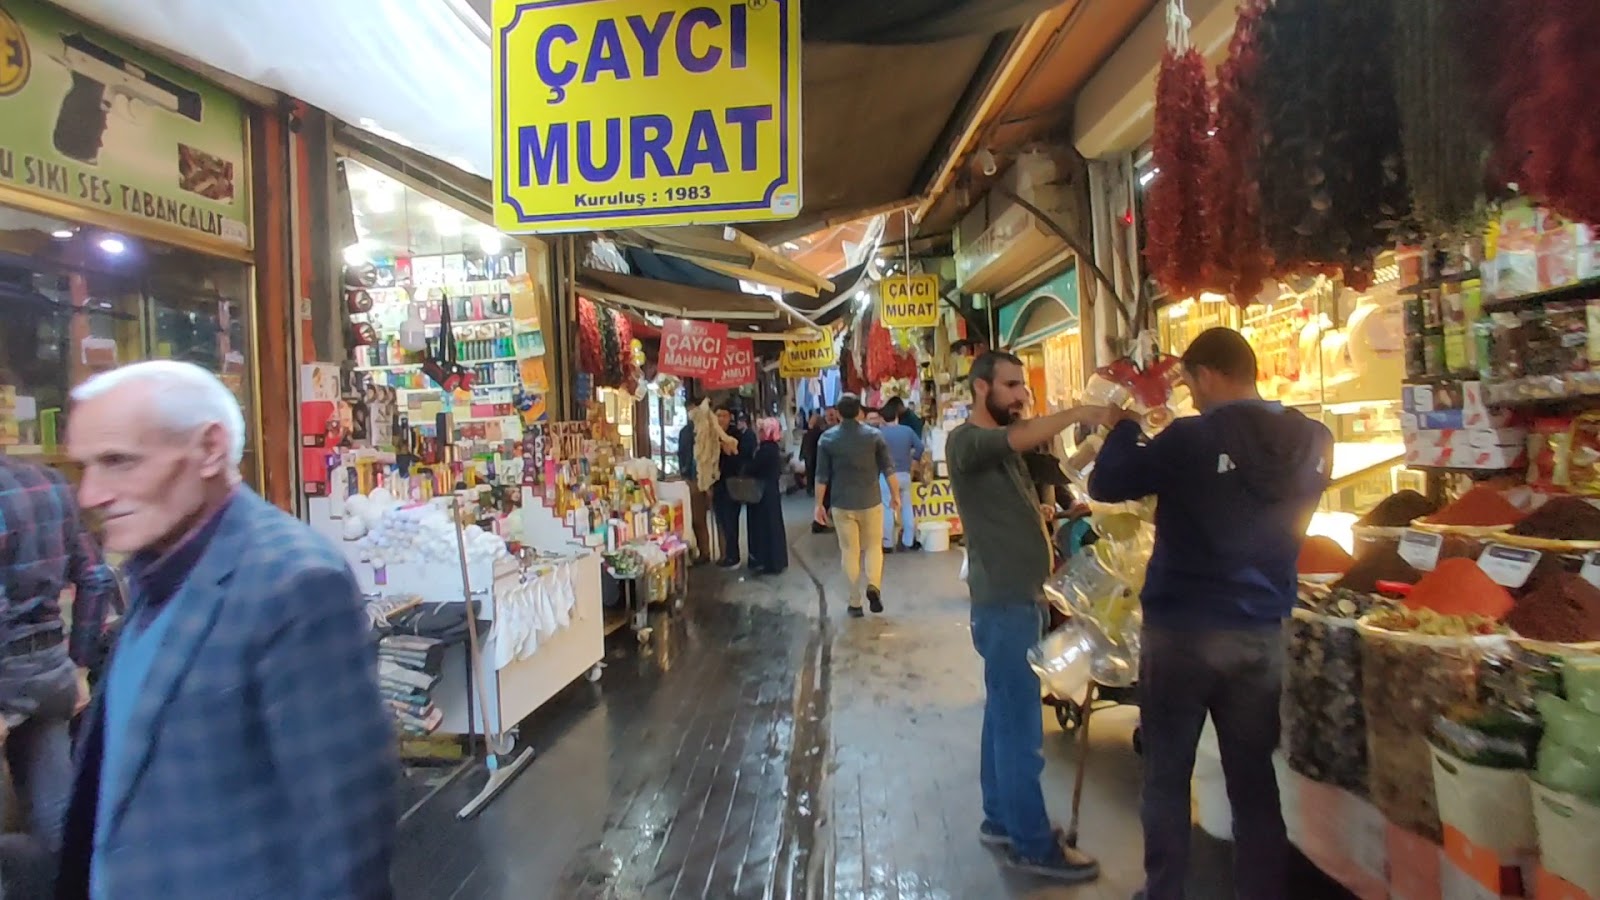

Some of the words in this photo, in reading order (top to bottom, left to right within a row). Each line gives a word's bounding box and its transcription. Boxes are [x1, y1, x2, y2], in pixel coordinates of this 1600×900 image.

[535, 3, 747, 104] ÇAYCI
[518, 105, 772, 187] MURAT
[24, 156, 68, 194] SIKI
[78, 172, 112, 205] SES
[574, 190, 646, 207] Kuruluş
[664, 186, 712, 202] 1983
[889, 282, 929, 299] ÇAYCI
[886, 303, 934, 318] MURAT
[664, 352, 720, 371] MAHMUT
[791, 347, 830, 361] MURAT
[912, 501, 956, 518] MUR
